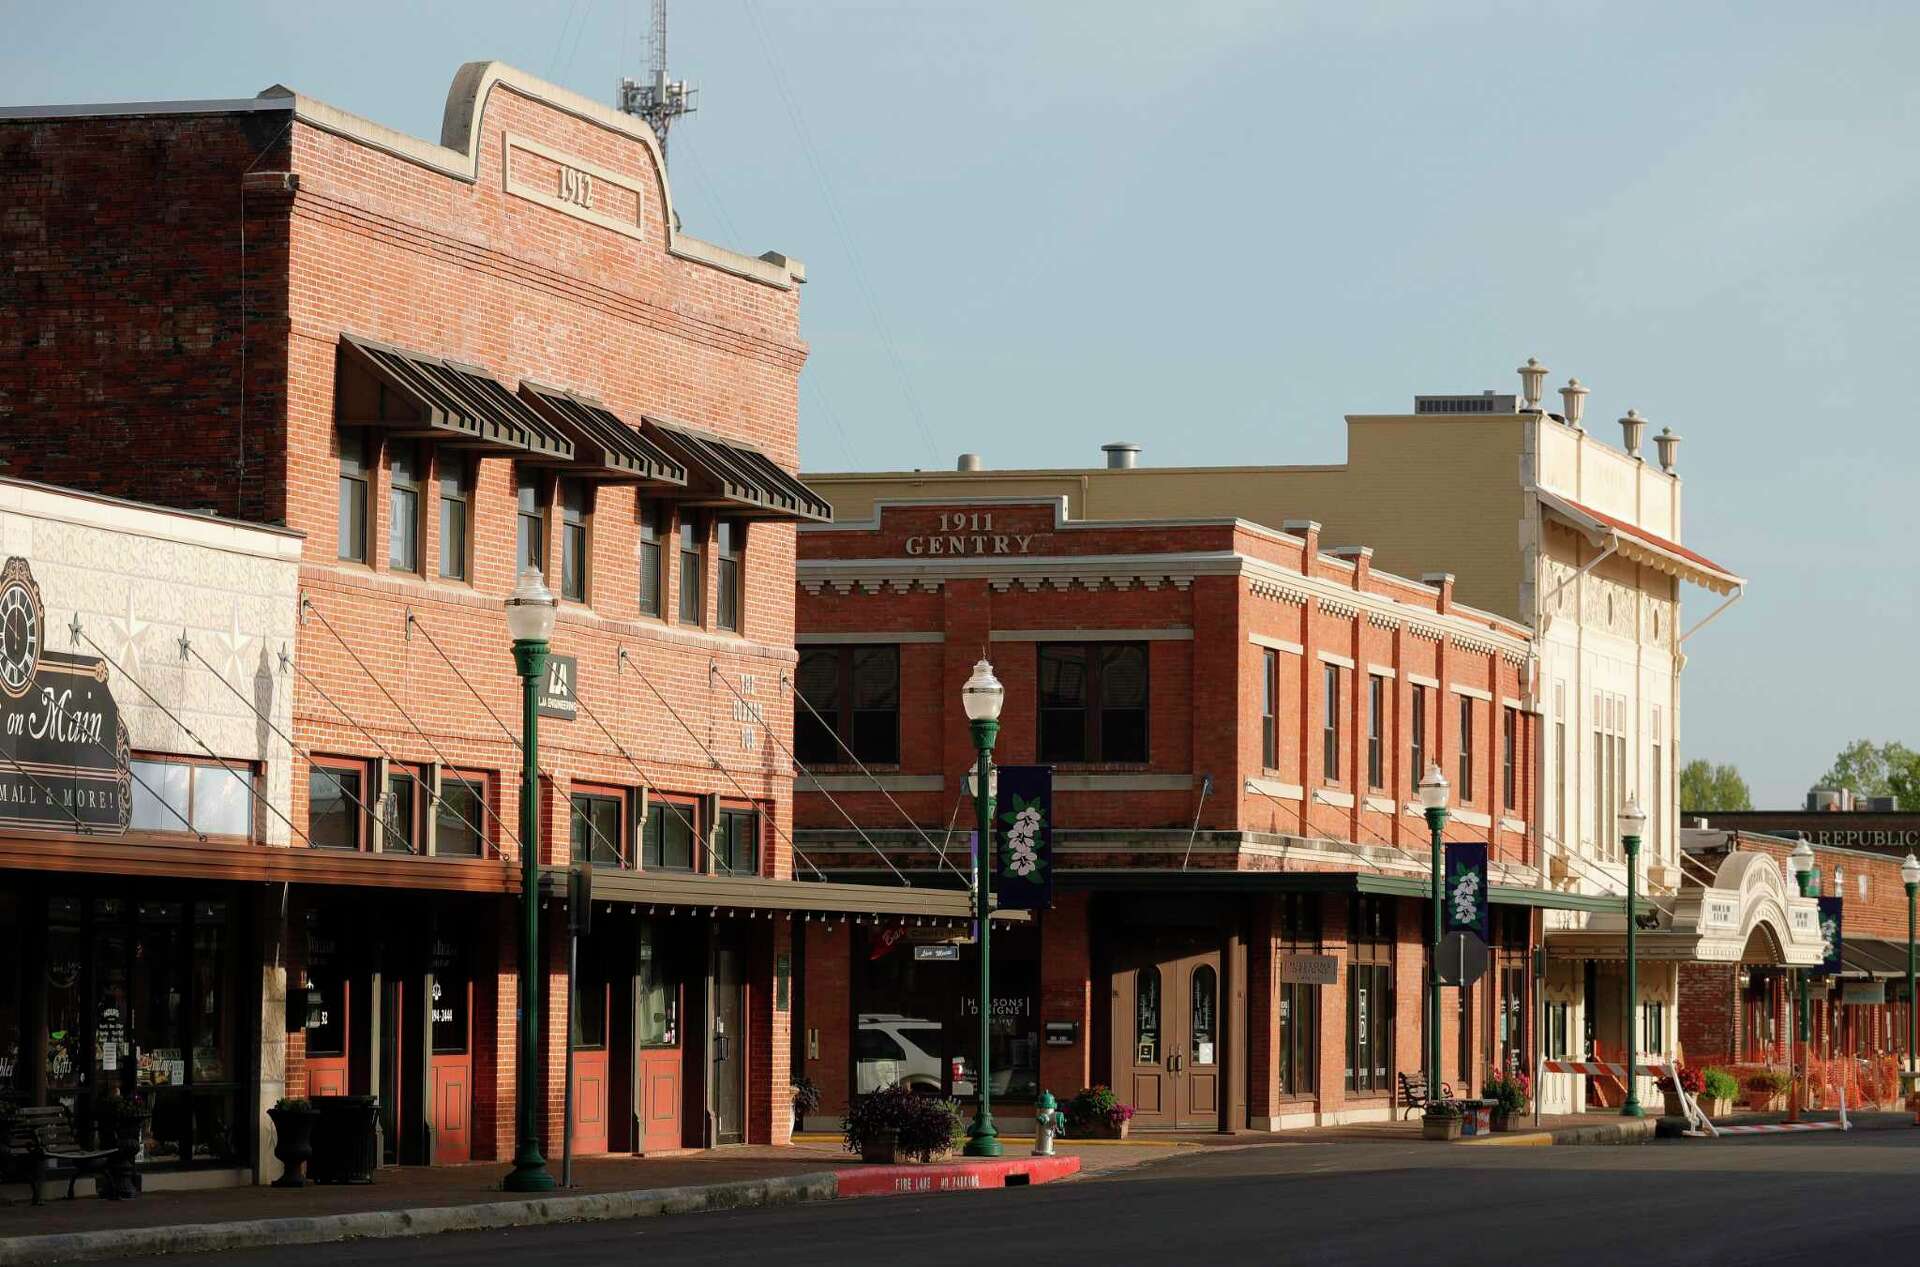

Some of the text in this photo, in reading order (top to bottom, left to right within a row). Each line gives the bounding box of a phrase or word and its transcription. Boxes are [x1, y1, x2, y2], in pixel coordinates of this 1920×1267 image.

[559, 164, 593, 209] 1912
[939, 512, 993, 532] 1911
[905, 534, 1034, 555] GENTRY
[7, 686, 103, 744] on Main
[0, 783, 36, 804] MALL
[63, 788, 114, 809] MORE!
[1818, 830, 1919, 847] REPUBLIC
[971, 1006, 1020, 1015] DIGNS
[53, 1055, 72, 1080] Gifts
[895, 1177, 912, 1191] FIRE
